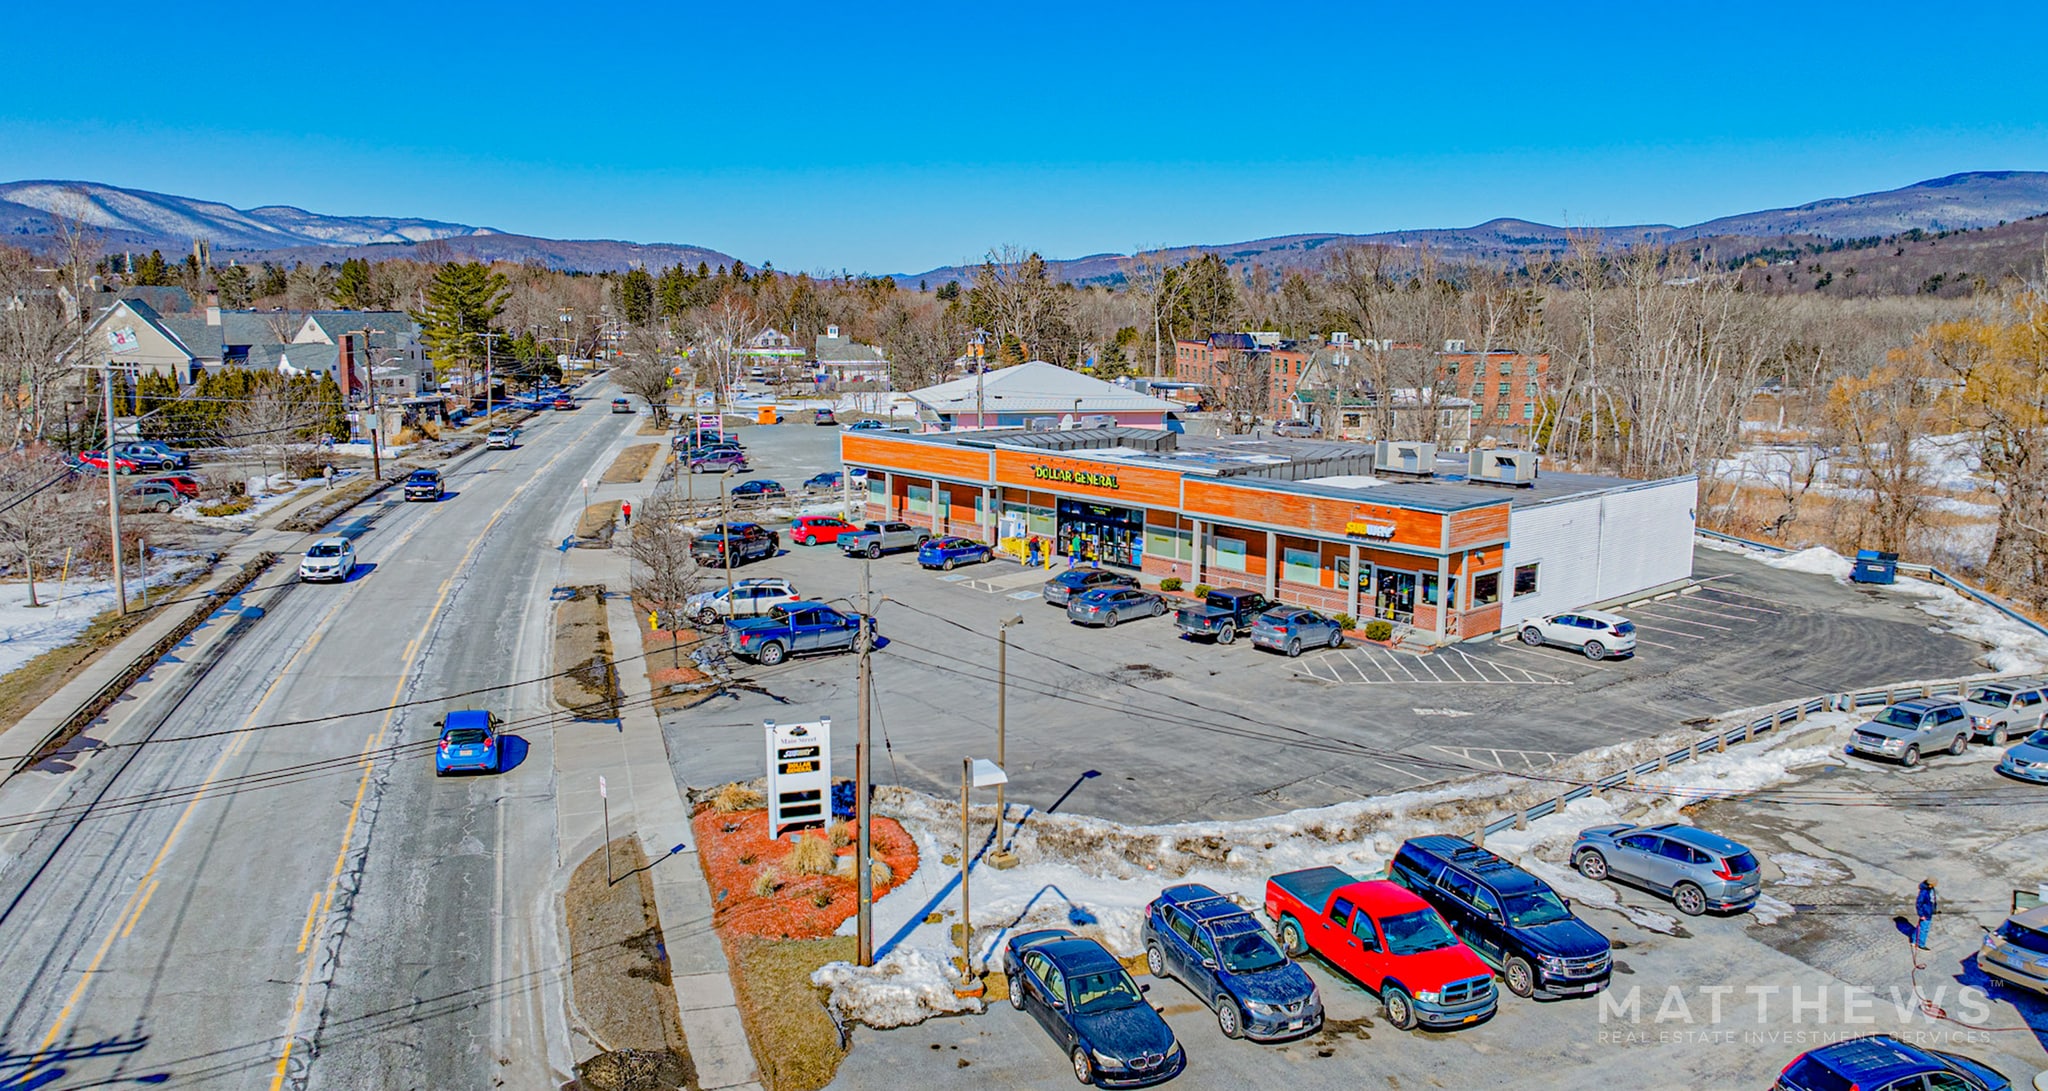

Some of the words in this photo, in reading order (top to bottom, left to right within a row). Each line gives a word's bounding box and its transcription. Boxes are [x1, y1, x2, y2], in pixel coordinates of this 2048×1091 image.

[1035, 466, 1073, 482] DOLLAR
[1074, 471, 1119, 489] GENERAL
[1344, 521, 1396, 538] SUBWAY
